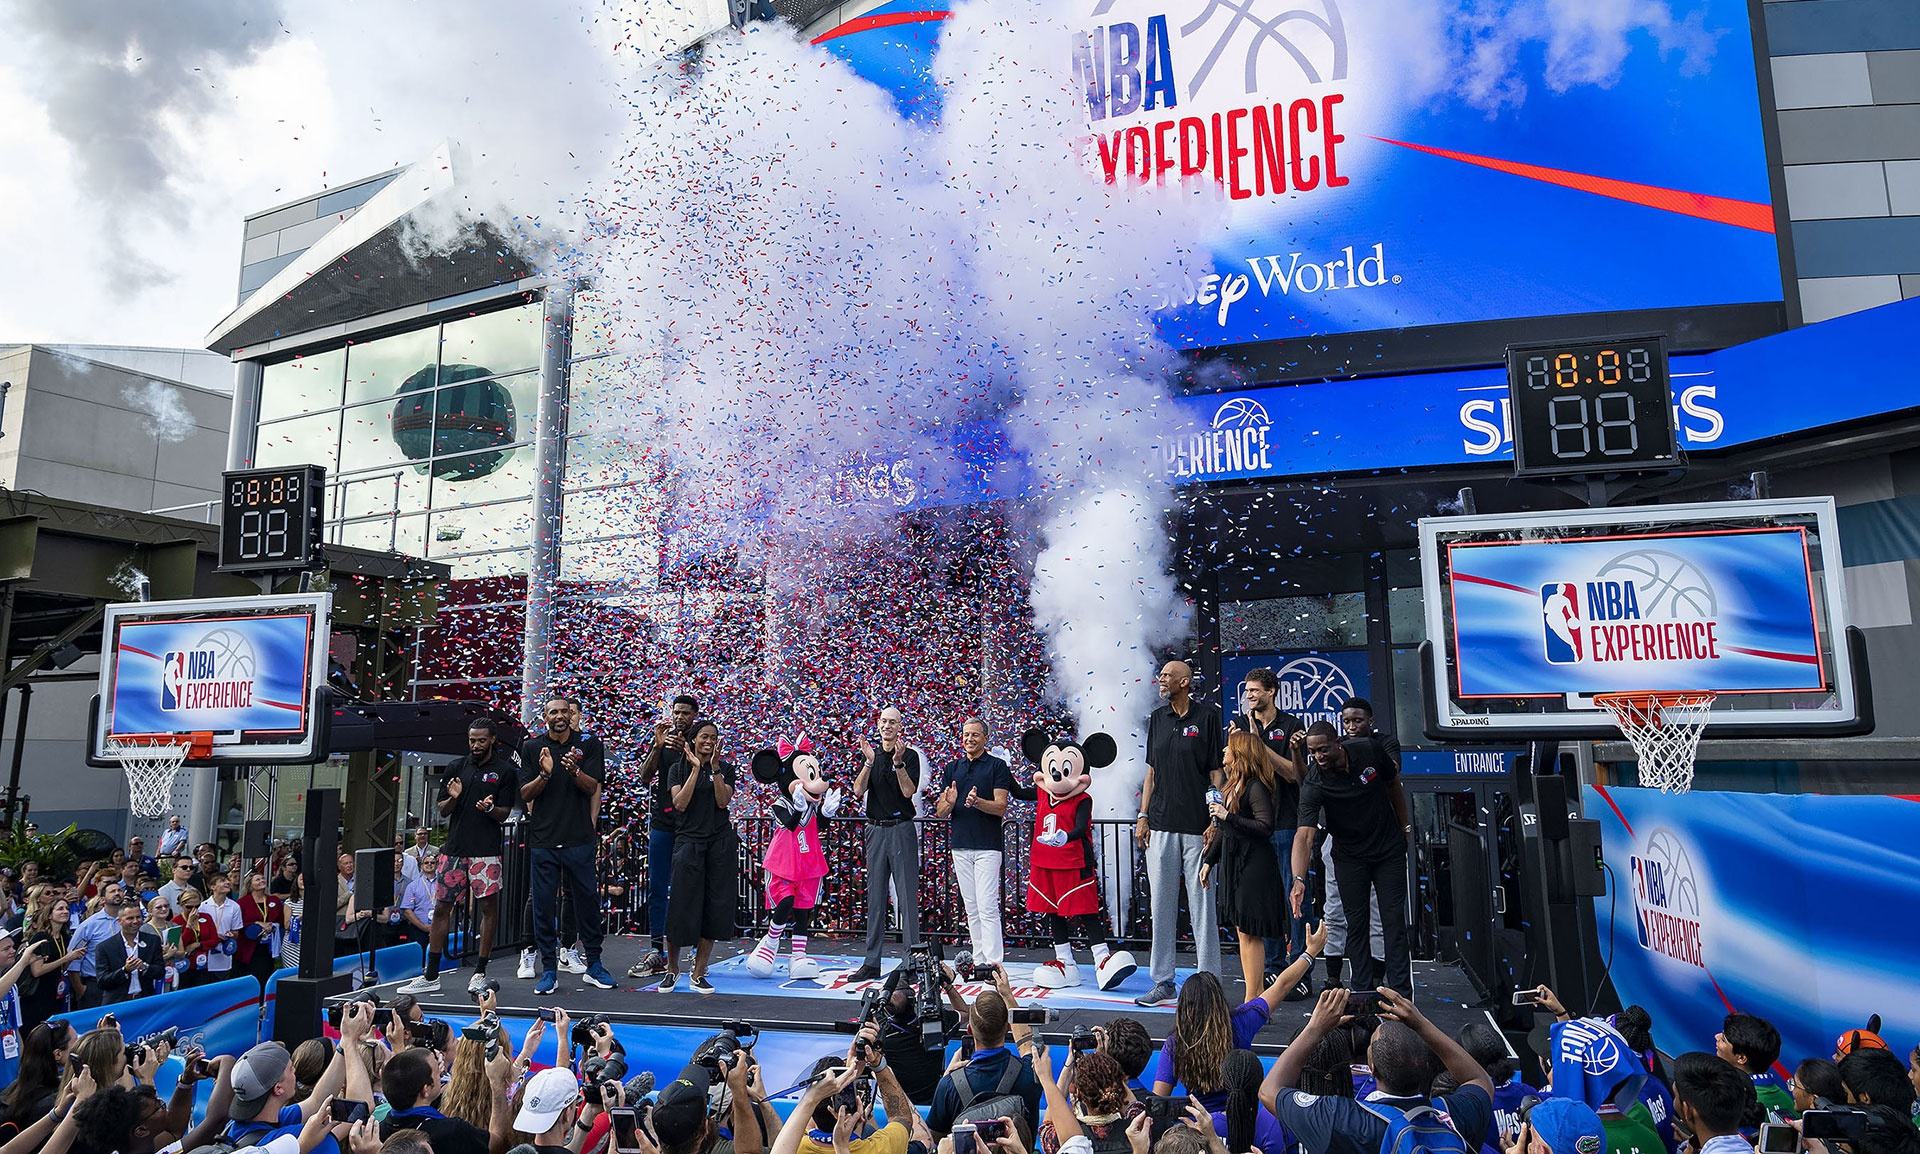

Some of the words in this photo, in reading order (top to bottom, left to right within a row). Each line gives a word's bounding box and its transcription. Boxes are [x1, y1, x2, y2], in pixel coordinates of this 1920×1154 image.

[1072, 14, 1177, 121] NBA
[1077, 93, 1350, 200] XPERIENCE
[1587, 580, 1640, 622] NBA
[1591, 622, 1720, 662] EXPERIENCE
[187, 650, 215, 681] NBA
[185, 681, 254, 709] EXPERIENCE
[1450, 716, 1490, 727] SPALDING
[1454, 752, 1506, 774] ENTRANCE
[797, 830, 810, 853] 1
[1043, 813, 1057, 839] 1
[1644, 859, 1668, 908] NBA
[1649, 909, 1705, 968] EXPERIENCE
[1493, 1108, 1523, 1138] Wes
[1646, 1094, 1668, 1126] West
